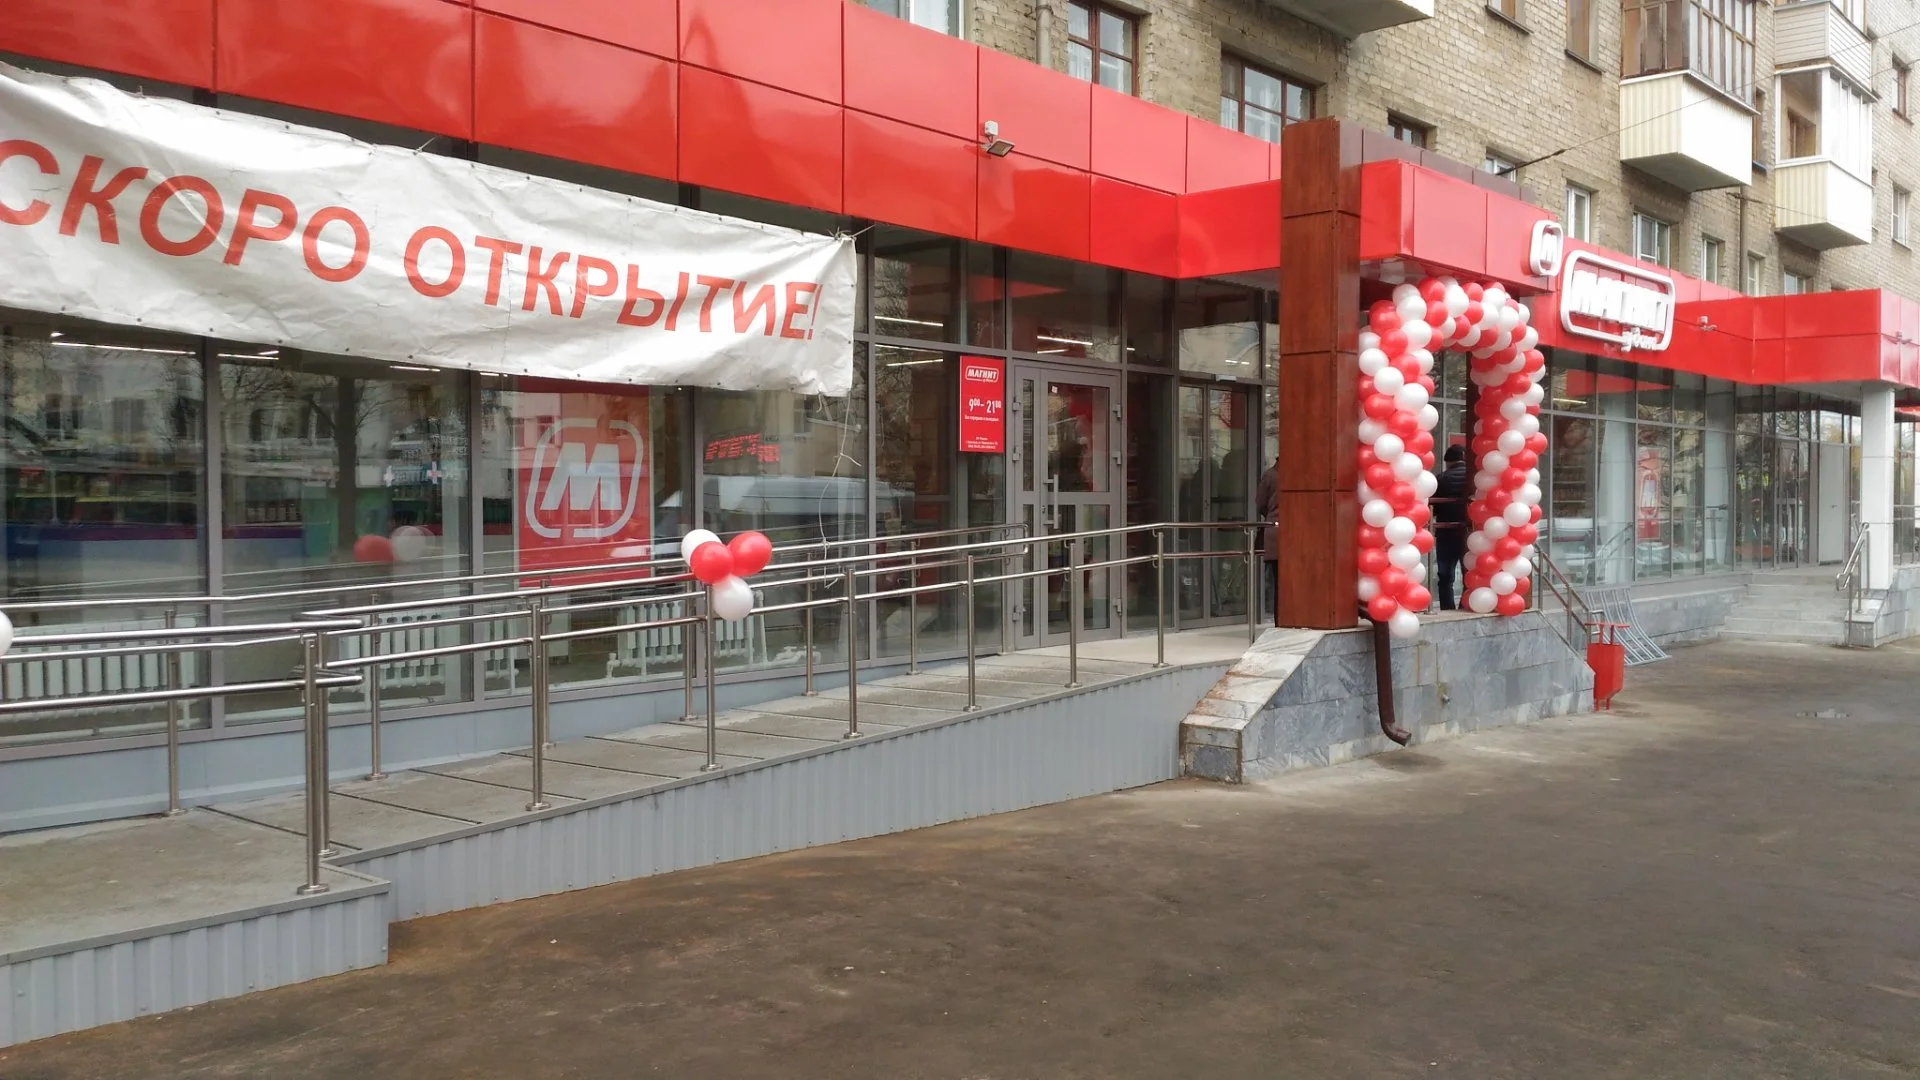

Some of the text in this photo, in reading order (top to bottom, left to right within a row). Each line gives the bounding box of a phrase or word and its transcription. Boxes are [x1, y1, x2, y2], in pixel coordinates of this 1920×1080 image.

[0, 140, 823, 341] СКОРО ОТКРЫТИЕ!
[968, 369, 997, 379] МАГНИТ
